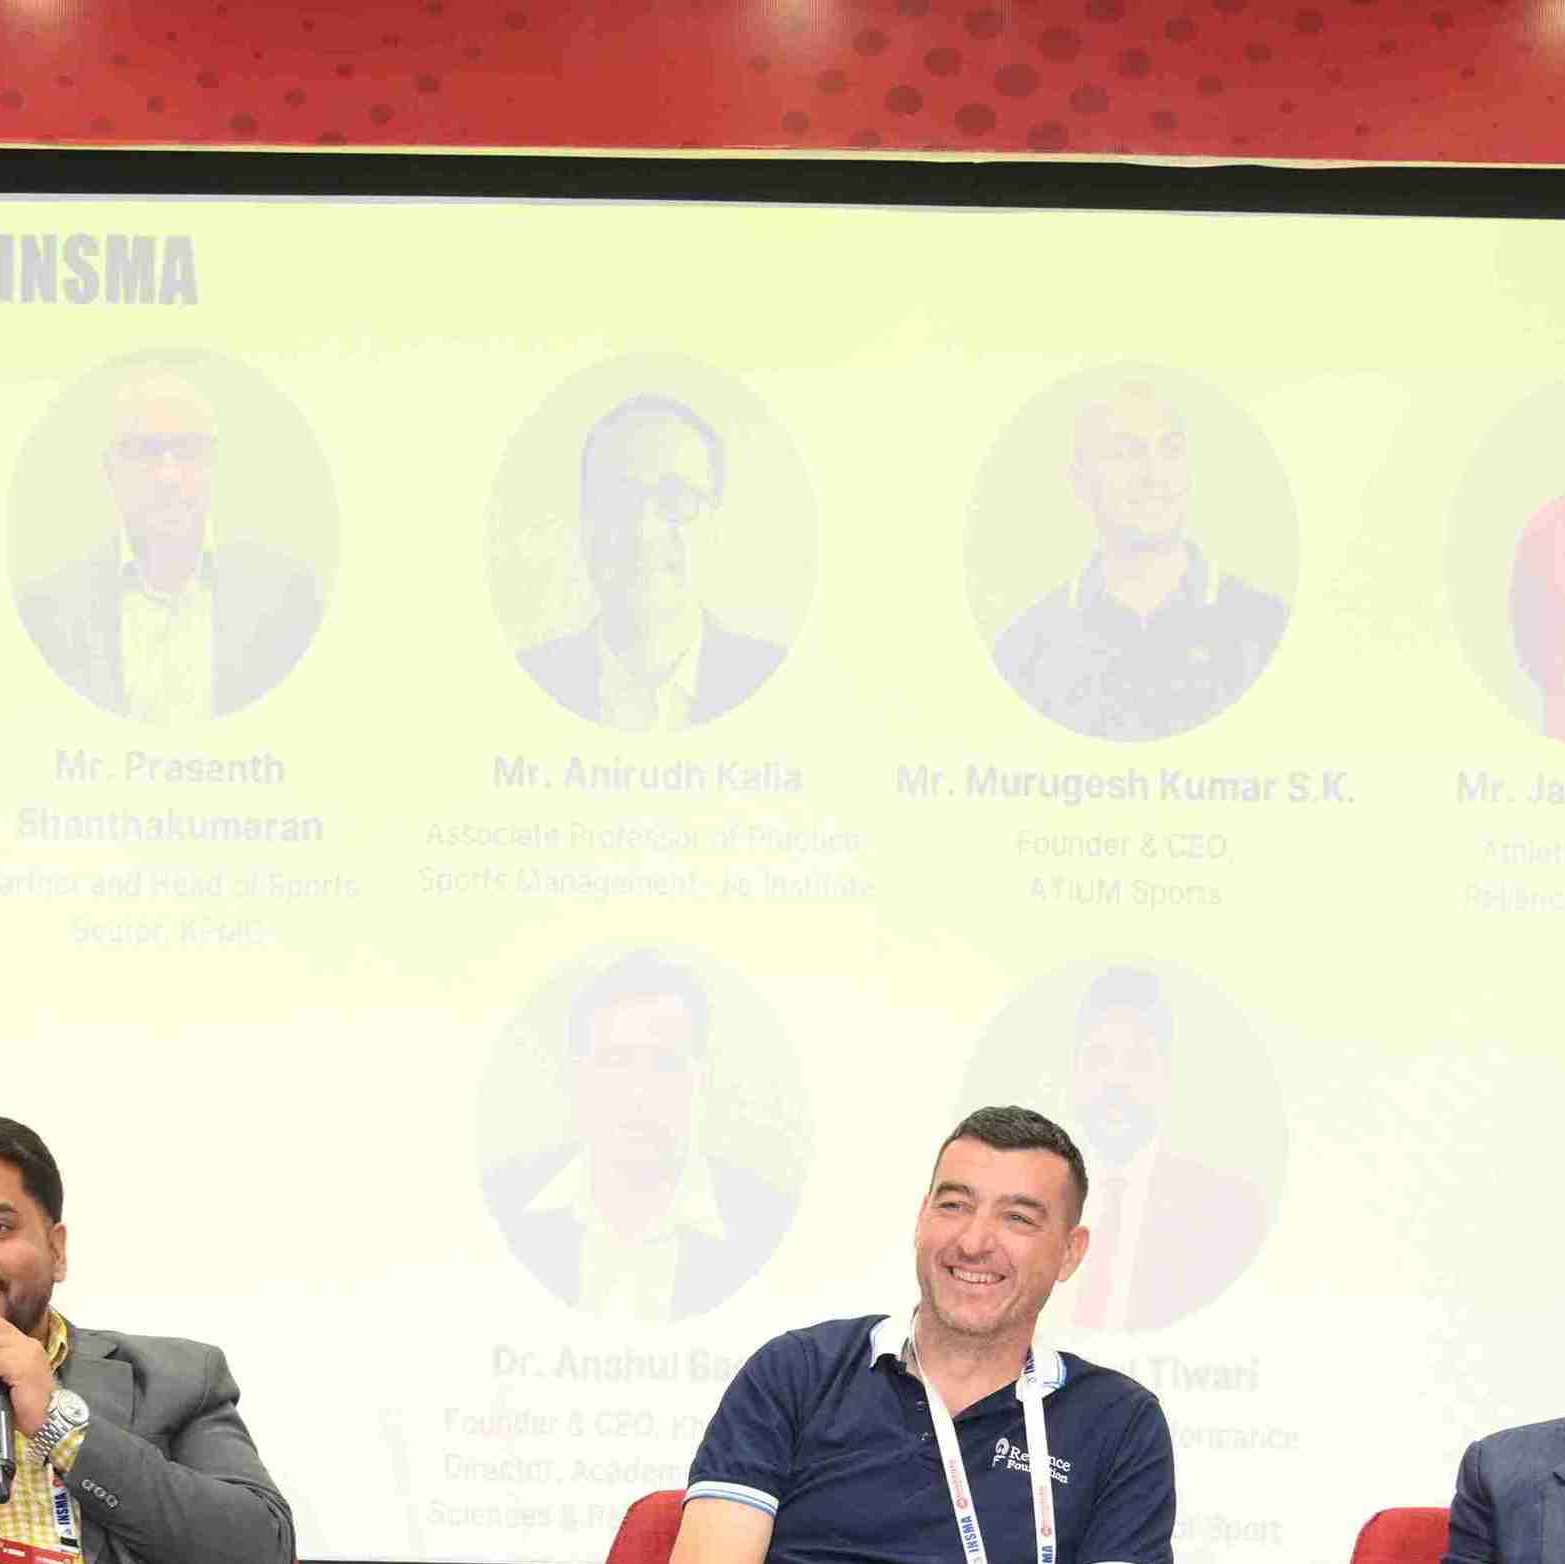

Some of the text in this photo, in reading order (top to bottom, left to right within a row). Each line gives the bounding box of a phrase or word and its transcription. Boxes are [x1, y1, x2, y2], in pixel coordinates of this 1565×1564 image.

[491, 753, 553, 793] Mr.
[563, 755, 707, 793] Anirudh
[894, 761, 1357, 807] Mr. Murugesh Kumar S.K.
[1457, 769, 1516, 806] Mr.
[1013, 829, 1131, 859] Founder
[1138, 832, 1158, 859] &
[571, 1457, 690, 1486] Academ
[1009, 1446, 1072, 1472] Rence
[53, 1493, 71, 1526] INSMA
[960, 1515, 980, 1553] INSMA
